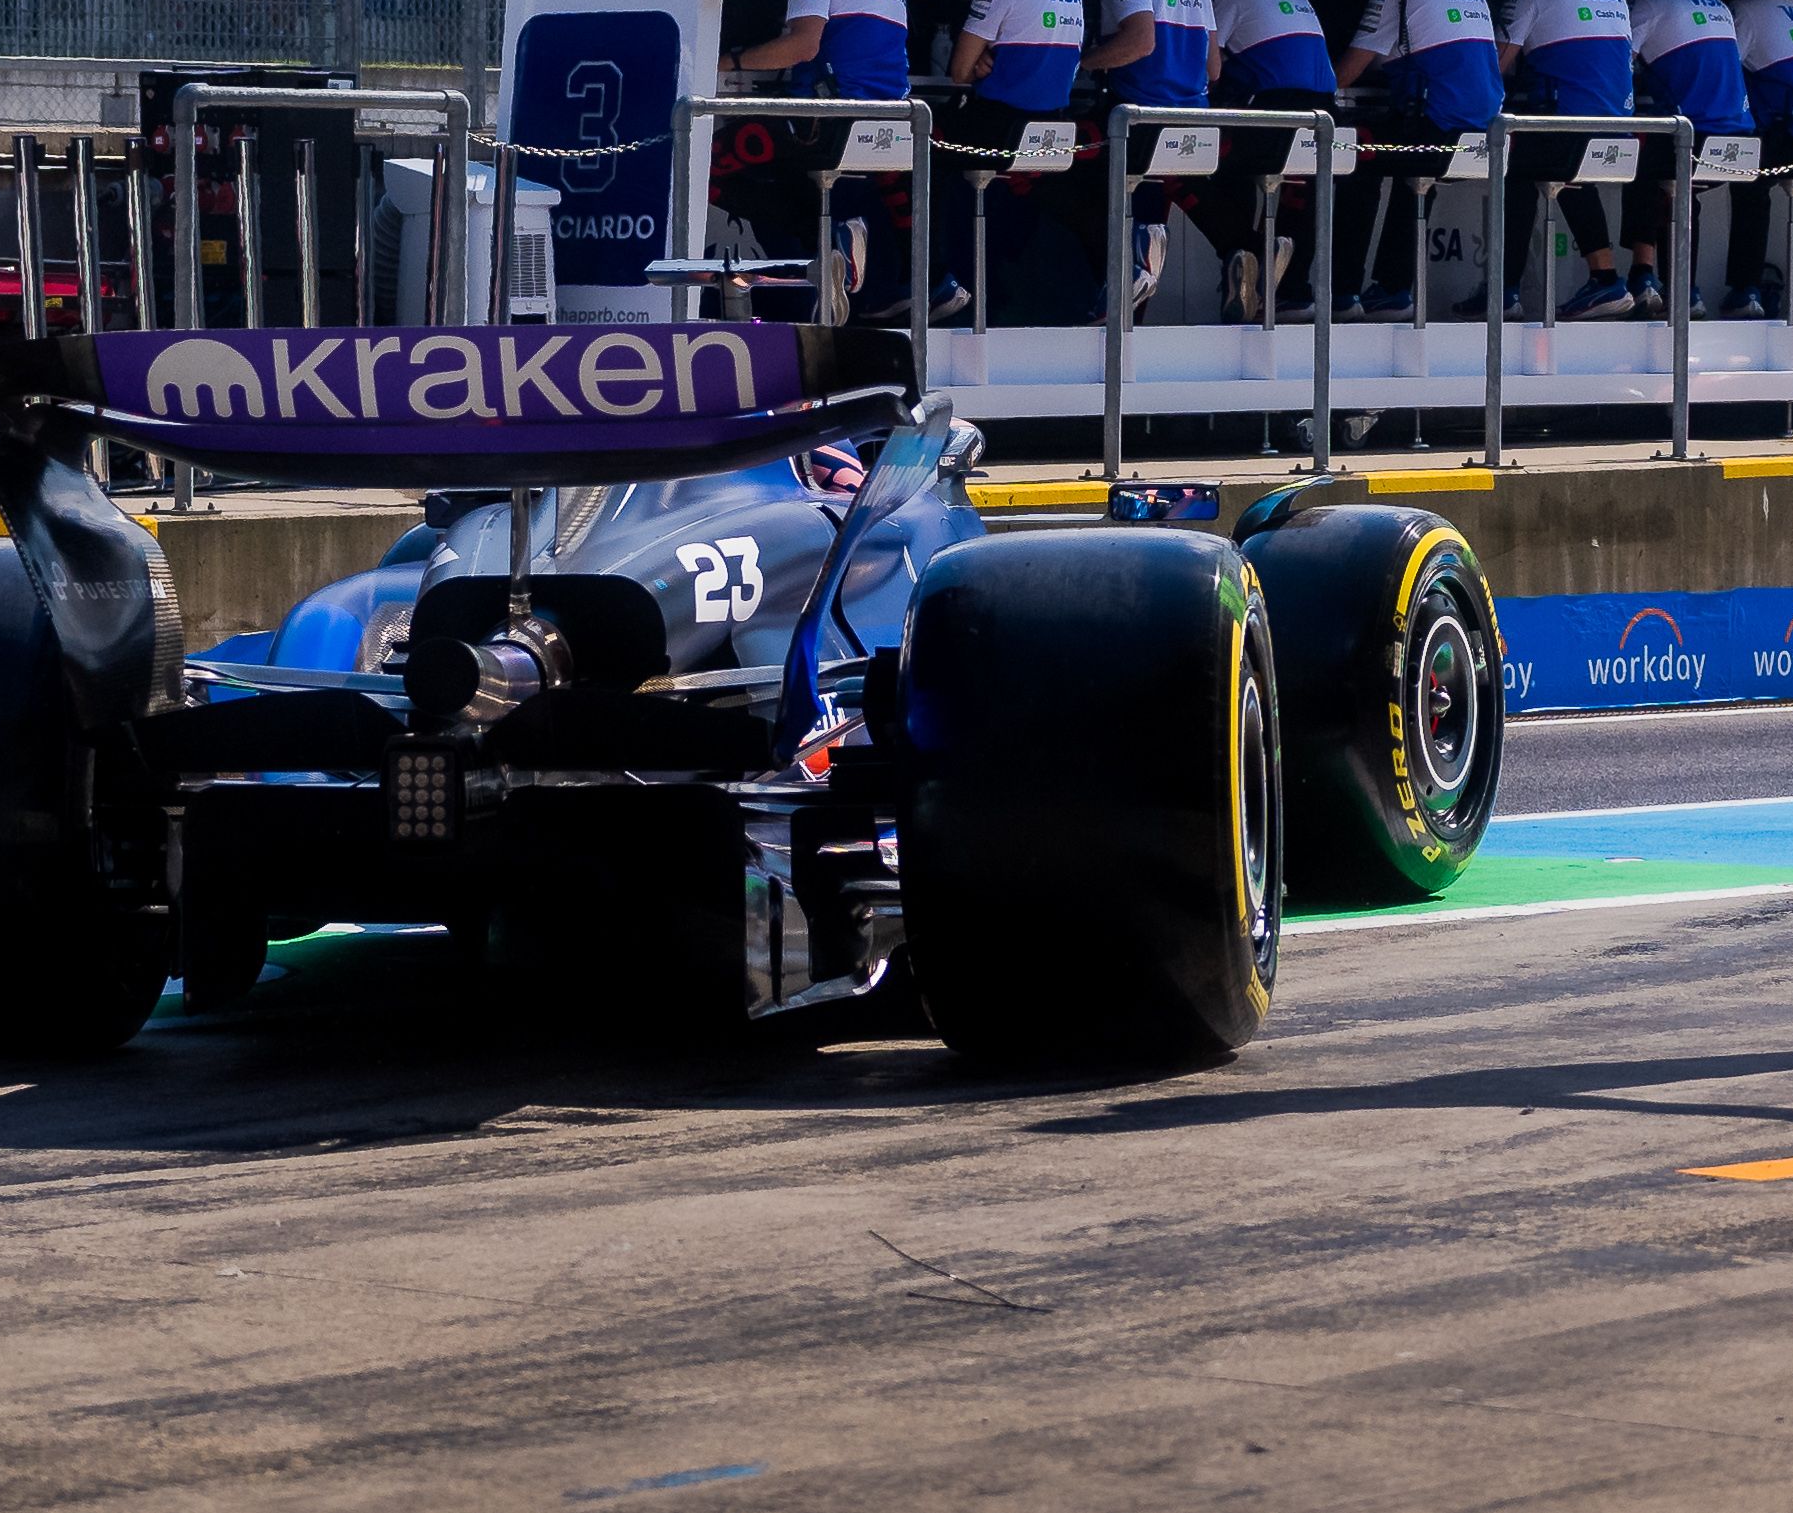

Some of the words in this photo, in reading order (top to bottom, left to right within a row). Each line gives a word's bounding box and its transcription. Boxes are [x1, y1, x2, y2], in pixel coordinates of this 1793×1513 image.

[1059, 16, 1075, 26] Cash
[1464, 10, 1480, 20] Cash
[1595, 9, 1615, 19] Cash
[560, 60, 623, 193] 3
[273, 331, 754, 419] kraken
[674, 536, 764, 623] 23
[1589, 644, 1705, 690] workday
[1388, 701, 1428, 841] ZERO
[1421, 836, 1441, 864] P
